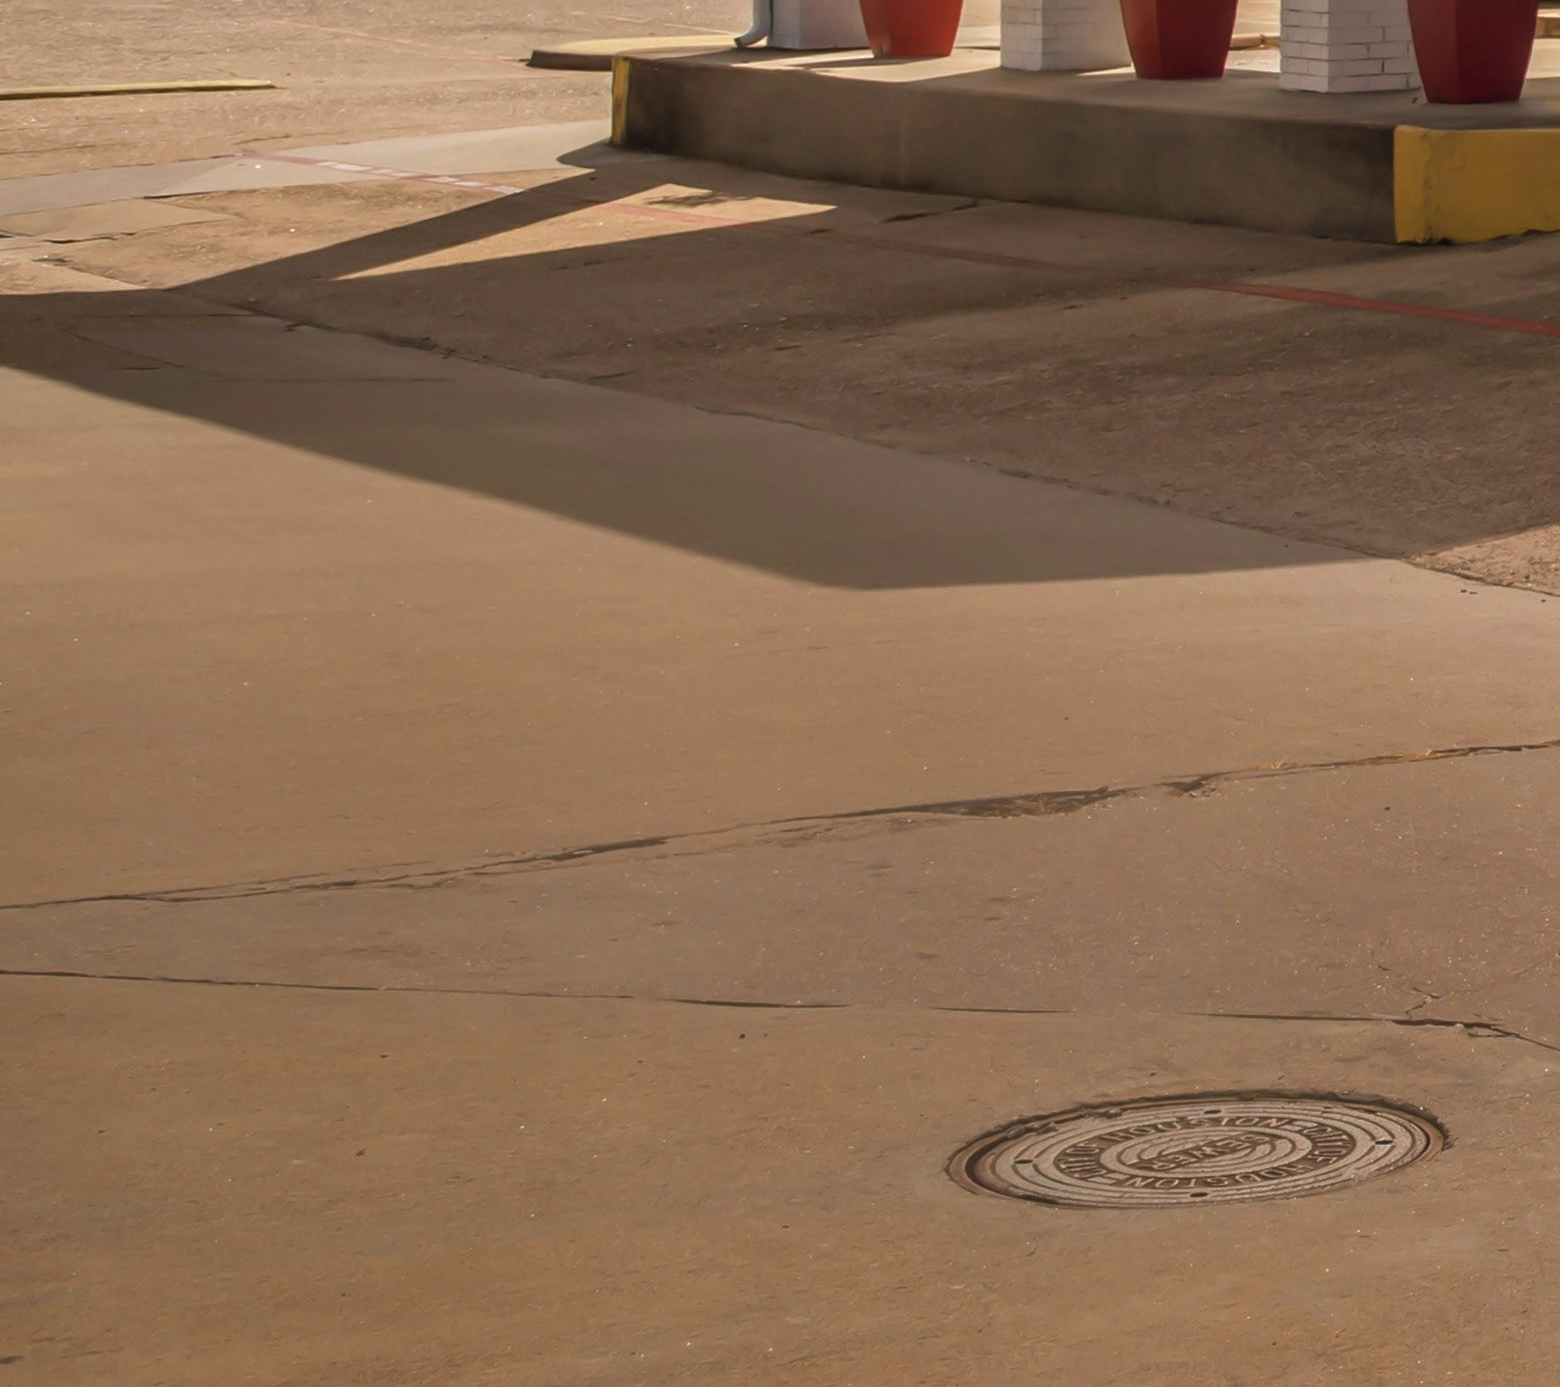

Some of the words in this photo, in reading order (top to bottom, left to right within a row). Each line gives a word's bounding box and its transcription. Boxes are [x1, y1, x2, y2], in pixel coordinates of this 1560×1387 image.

[1101, 1116, 1288, 1142] HOUSTON
[1149, 1134, 1270, 1171] SEWER
[1125, 1164, 1314, 1188] HOUSTON
